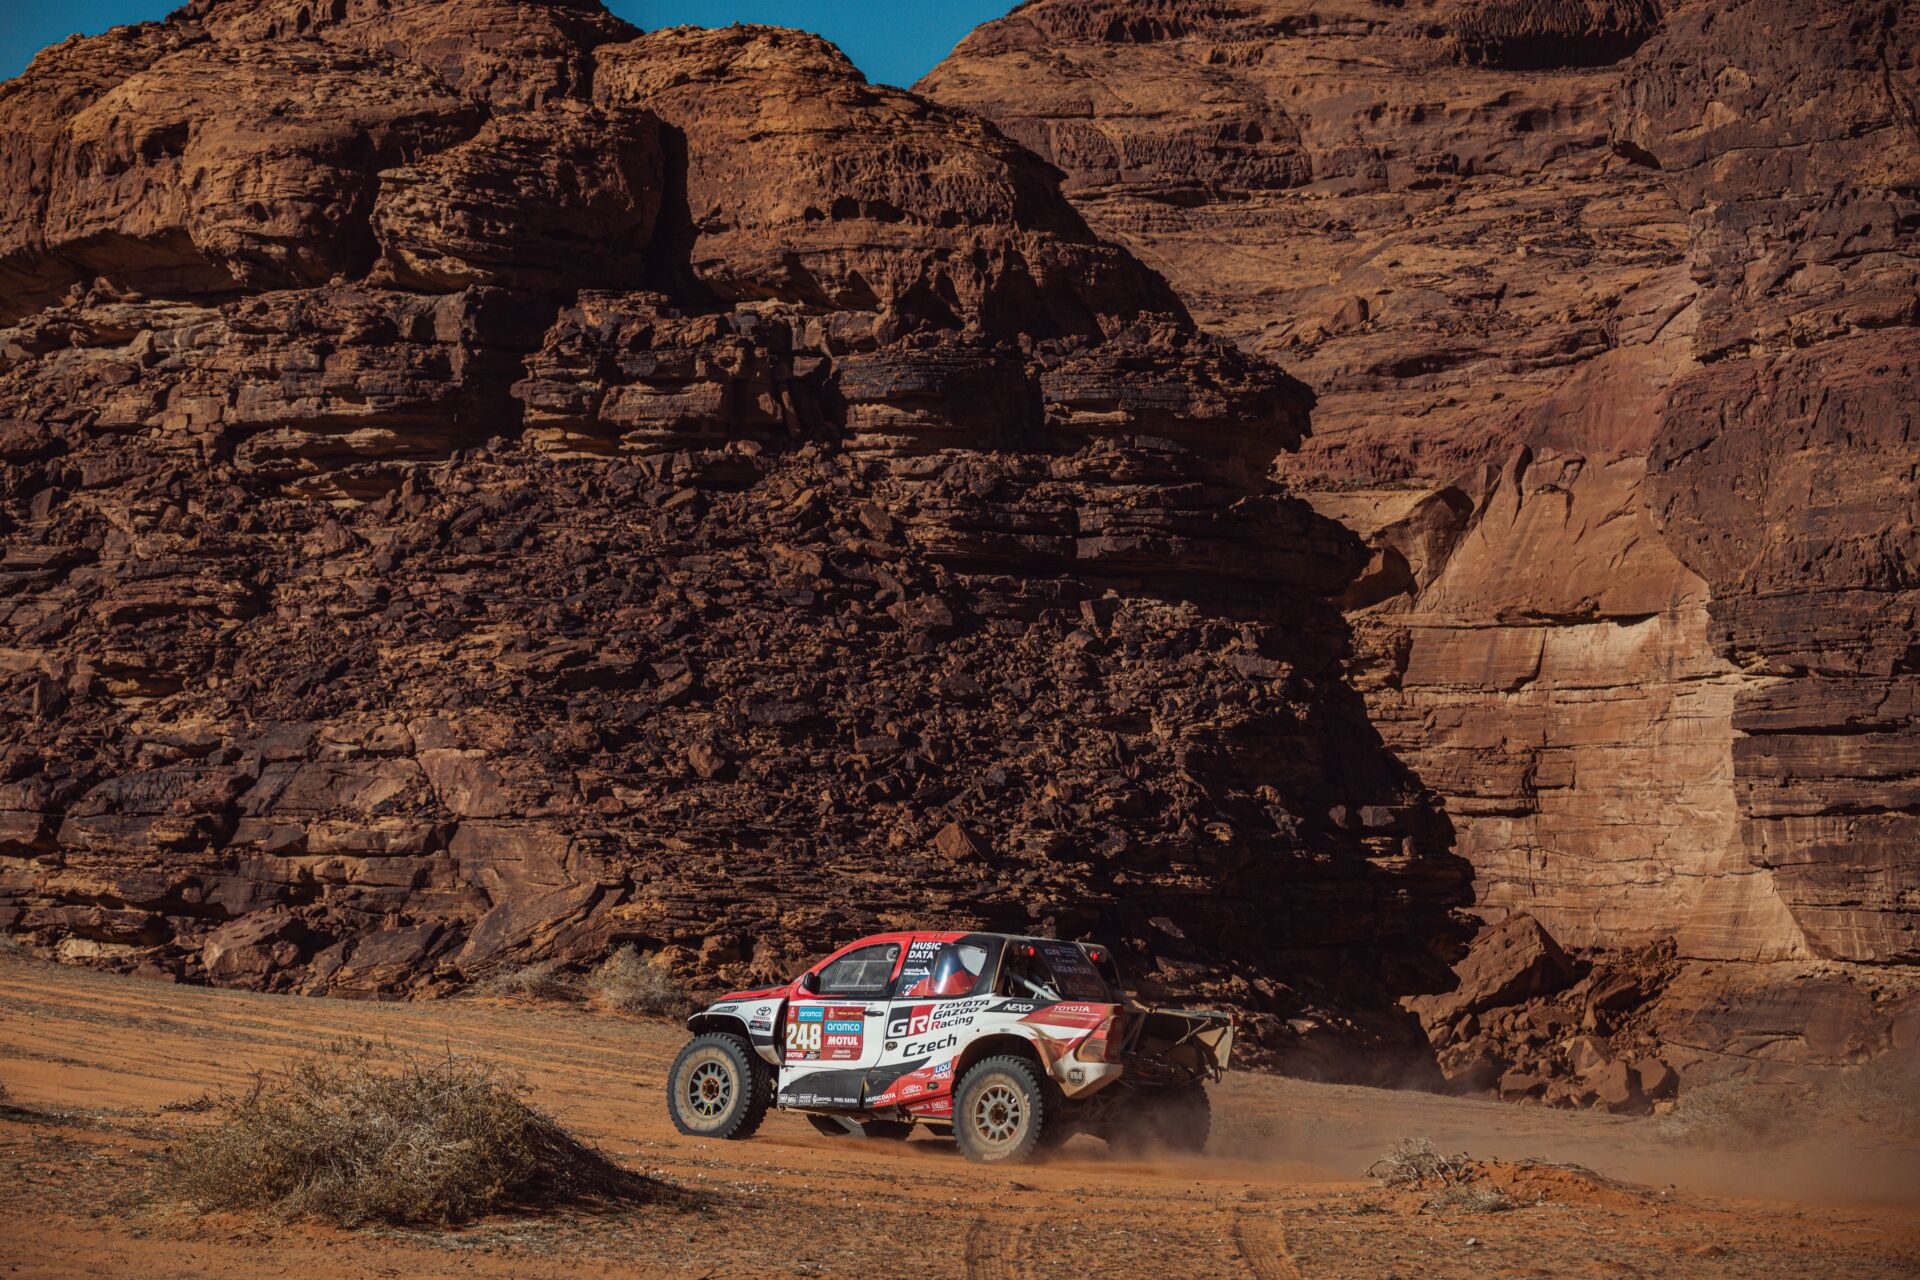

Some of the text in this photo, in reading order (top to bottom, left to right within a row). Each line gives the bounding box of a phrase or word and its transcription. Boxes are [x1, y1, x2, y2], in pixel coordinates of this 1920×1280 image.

[911, 942, 941, 950] MUSIC
[908, 951, 933, 959] DATA
[938, 1000, 990, 1010] TOYOTA
[1003, 1003, 1034, 1012] NEXO
[1053, 1005, 1090, 1013] TOYOTA
[933, 1007, 979, 1020] GAZOO
[827, 1022, 860, 1031] aramco
[887, 1014, 929, 1038] GR
[930, 1016, 974, 1031] Racing
[786, 1023, 821, 1050] 248
[827, 1036, 858, 1045] MOTUL
[902, 1034, 957, 1057] Czech
